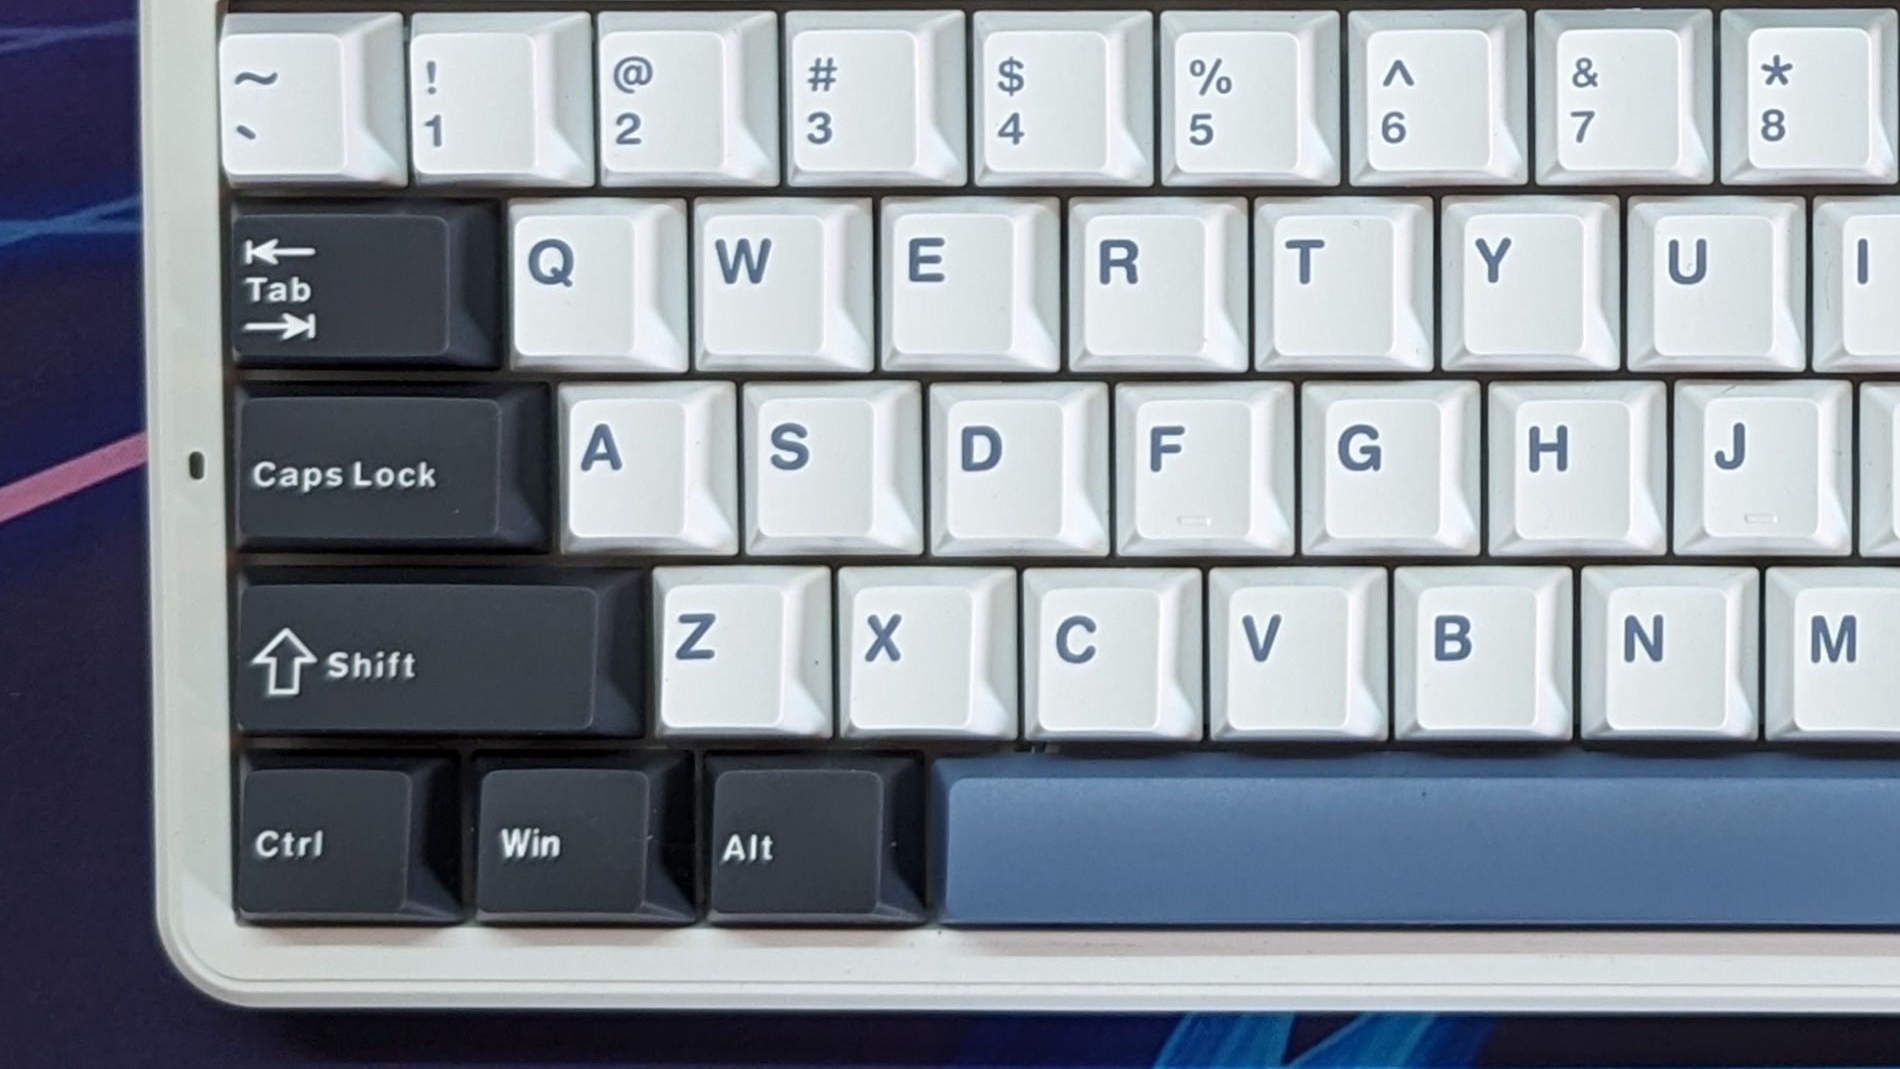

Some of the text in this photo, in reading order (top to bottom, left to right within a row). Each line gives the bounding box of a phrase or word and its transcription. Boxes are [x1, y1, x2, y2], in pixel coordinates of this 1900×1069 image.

[426, 60, 437, 96] !
[612, 55, 654, 95] @
[807, 57, 838, 92] #
[997, 56, 1025, 97] $
[1189, 58, 1233, 96] %
[1571, 57, 1598, 89] &
[424, 114, 442, 148] 1
[615, 112, 642, 145] 2
[806, 111, 833, 145] 3
[997, 112, 1025, 146] 4
[1189, 113, 1214, 146] 5
[1381, 111, 1407, 144] 6
[1570, 110, 1596, 144] 7
[1760, 108, 1786, 142] 8
[527, 238, 574, 288] Q
[714, 237, 772, 285] W
[908, 237, 945, 283] E
[1099, 239, 1139, 285] R
[1284, 239, 1326, 285] T
[1474, 237, 1512, 284] Y
[1668, 238, 1707, 286] U
[244, 276, 311, 303] Tab
[580, 423, 623, 472] A
[770, 422, 810, 471] S
[961, 425, 1003, 473] D
[1150, 425, 1186, 473] F
[1337, 424, 1382, 472] G
[1528, 424, 1568, 473] H
[1714, 422, 1746, 471] J
[252, 461, 436, 493] Caps Lock
[675, 613, 716, 661] Z
[864, 613, 902, 663] X
[1055, 615, 1097, 665] C
[1241, 614, 1282, 663] V
[1434, 614, 1473, 662] B
[1623, 614, 1664, 664] N
[1810, 614, 1857, 664] M
[326, 651, 415, 679] Shift
[254, 830, 323, 858] Ctrl
[500, 828, 561, 858] Win
[722, 834, 773, 862] Alt
